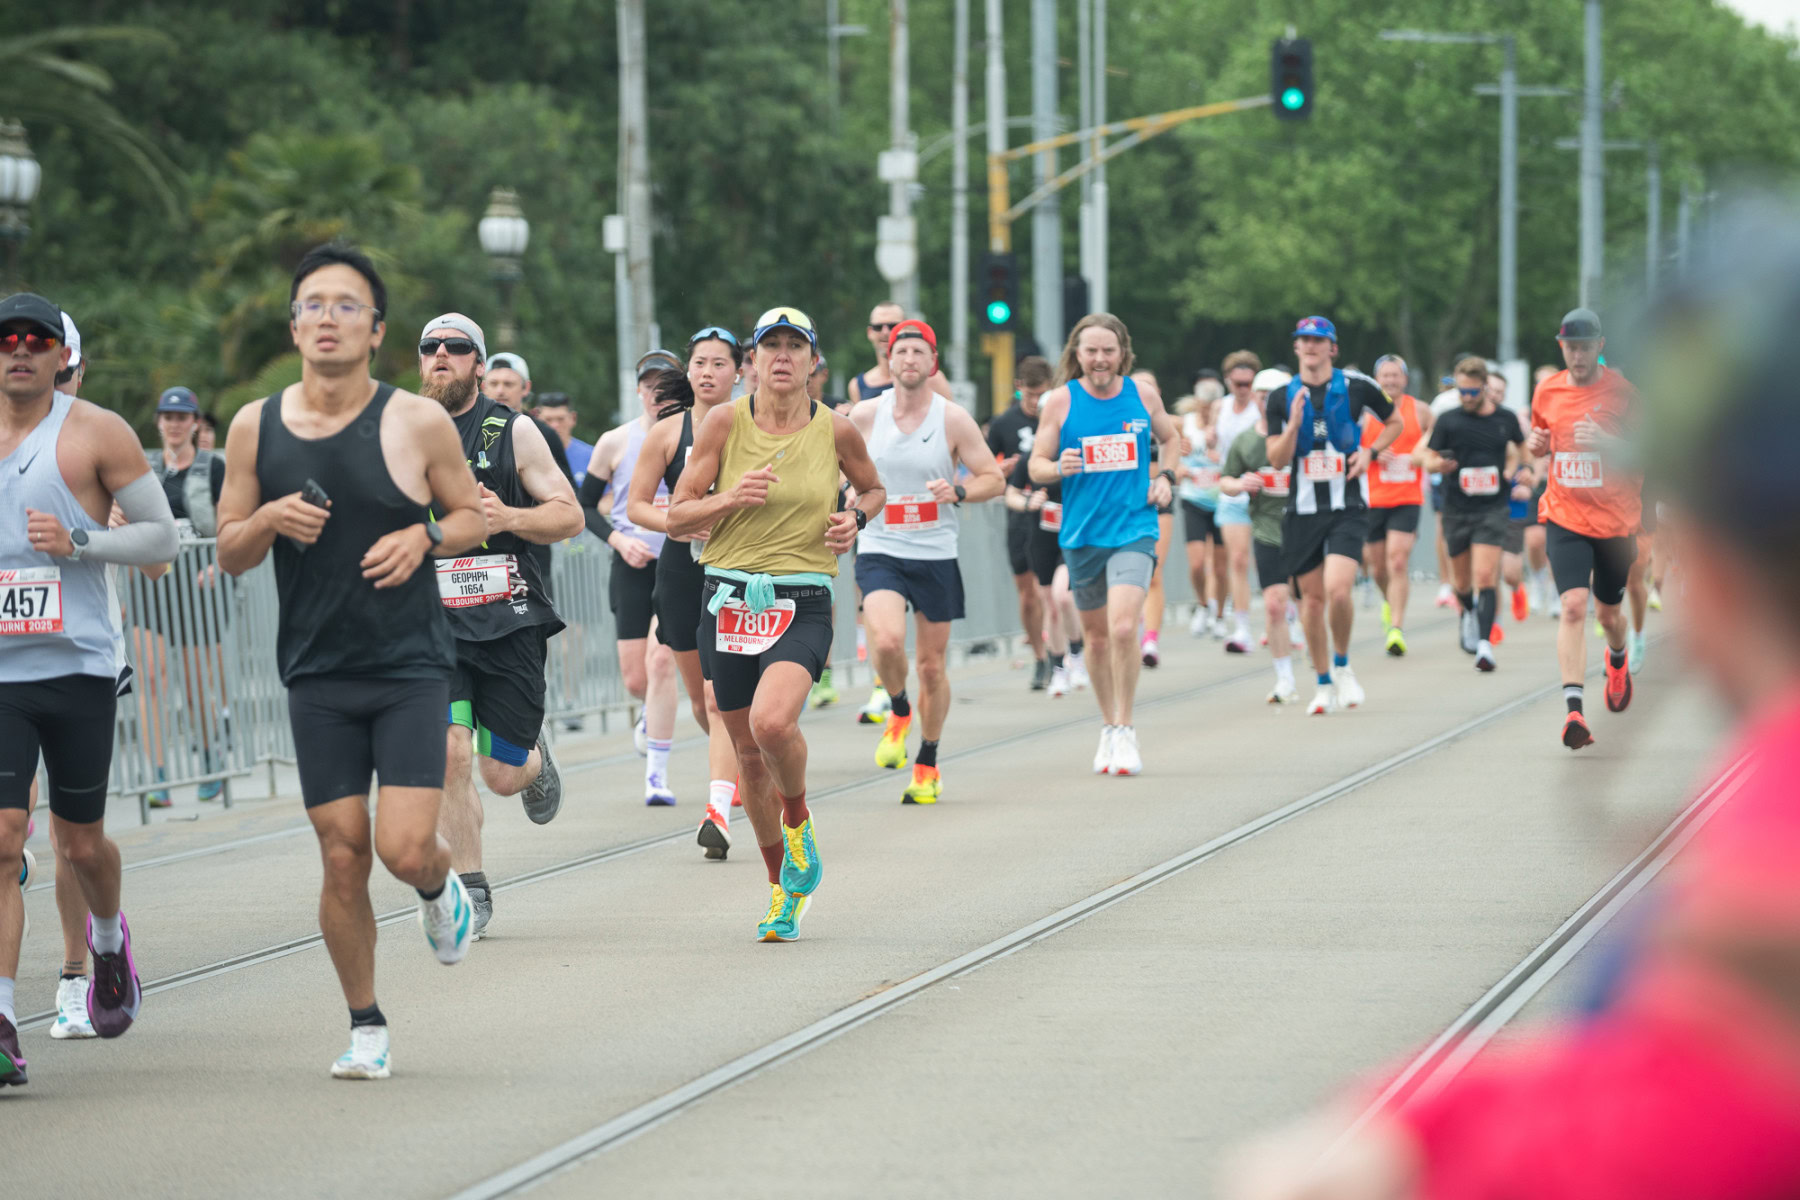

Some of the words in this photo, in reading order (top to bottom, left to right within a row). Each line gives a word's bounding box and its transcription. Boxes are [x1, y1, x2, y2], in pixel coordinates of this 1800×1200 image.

[1093, 443, 1129, 463] 5369
[451, 570, 489, 584] GEOPHPH
[459, 583, 485, 595] 11654
[0, 586, 49, 619] 457
[441, 596, 484, 606] MELBOURNE
[29, 619, 54, 632] 2025
[732, 610, 782, 636] 7807
[723, 635, 765, 645] MELBOURNE
